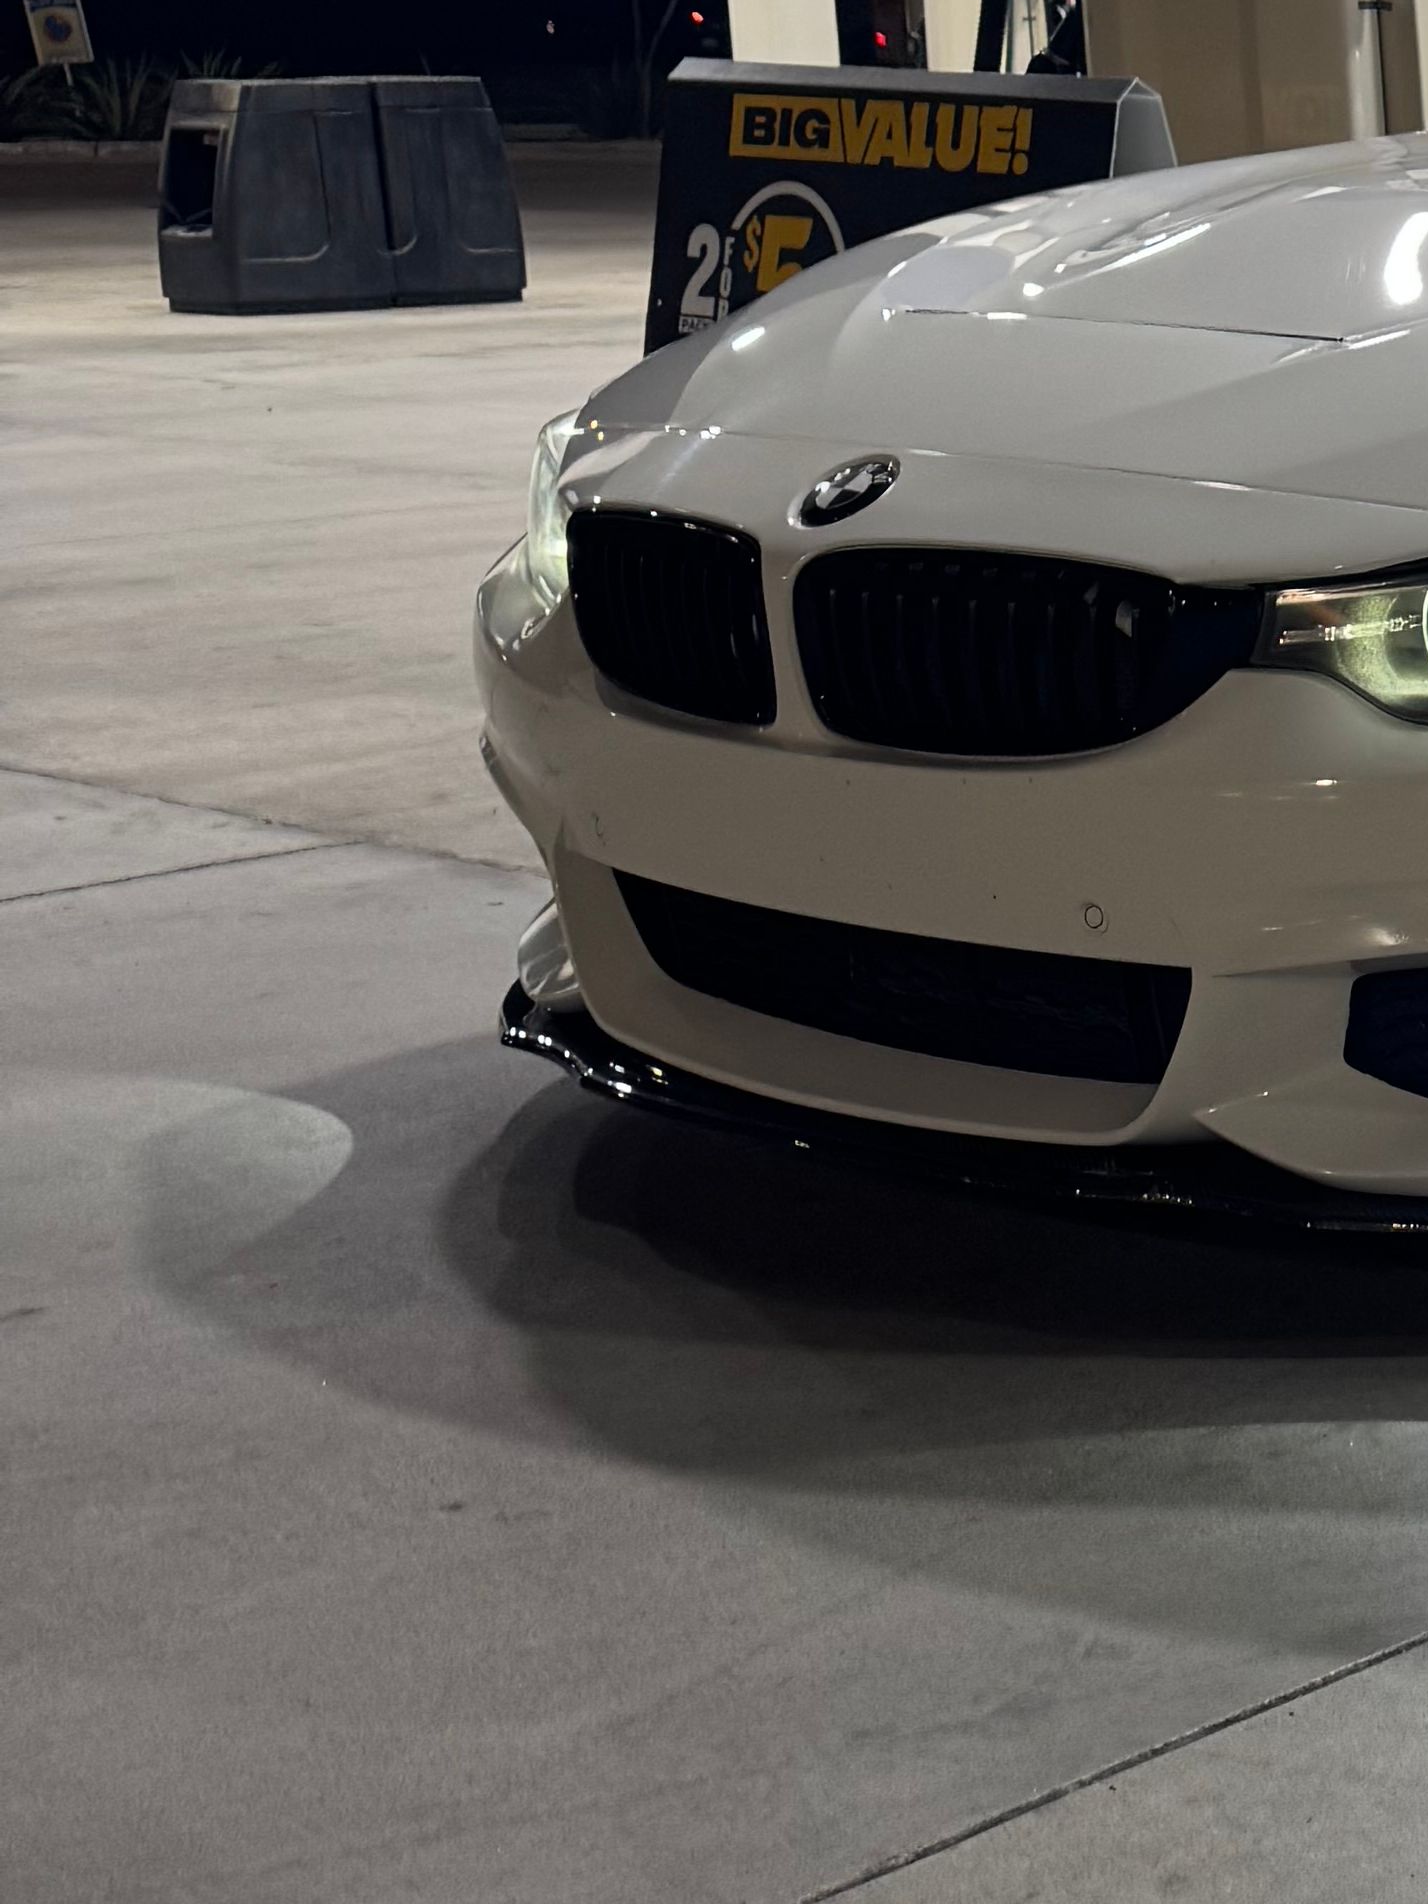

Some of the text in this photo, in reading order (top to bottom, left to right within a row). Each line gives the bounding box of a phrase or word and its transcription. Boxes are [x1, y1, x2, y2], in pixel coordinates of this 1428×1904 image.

[742, 98, 1033, 176] BIG VALUE!
[680, 222, 720, 319] 2
